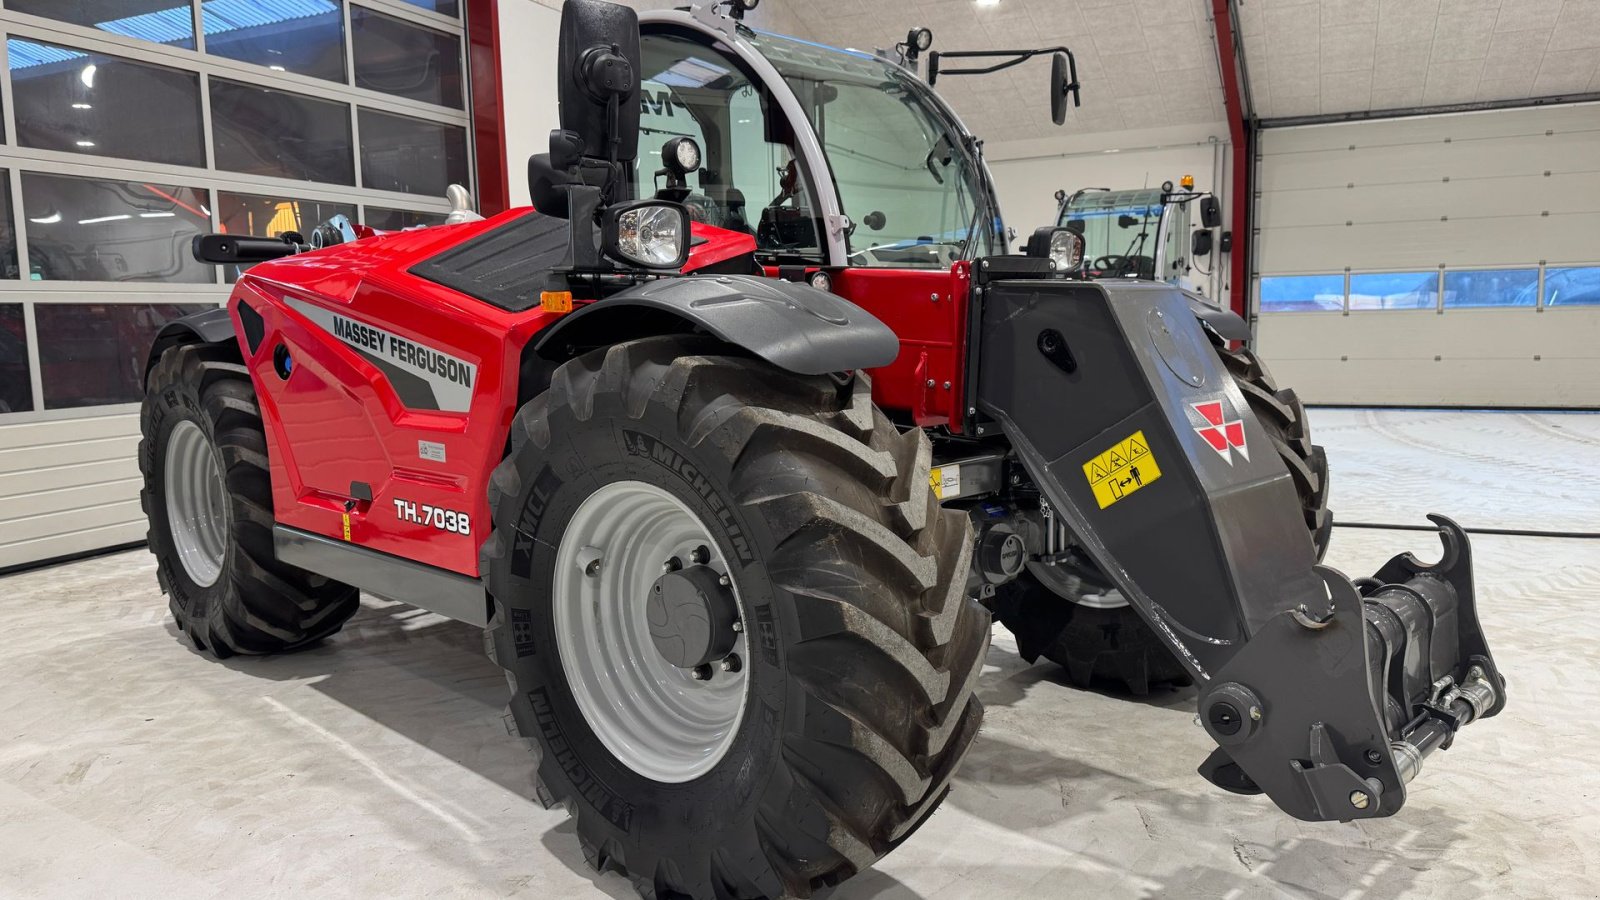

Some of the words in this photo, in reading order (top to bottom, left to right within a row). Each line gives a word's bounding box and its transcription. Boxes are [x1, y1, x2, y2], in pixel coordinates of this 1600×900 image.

[333, 316, 386, 351] MASSEY
[390, 336, 471, 387] FERGUSON
[393, 499, 470, 535] TH.7038
[652, 441, 752, 560] MICHELIN
[529, 690, 612, 810] MICHELIN
